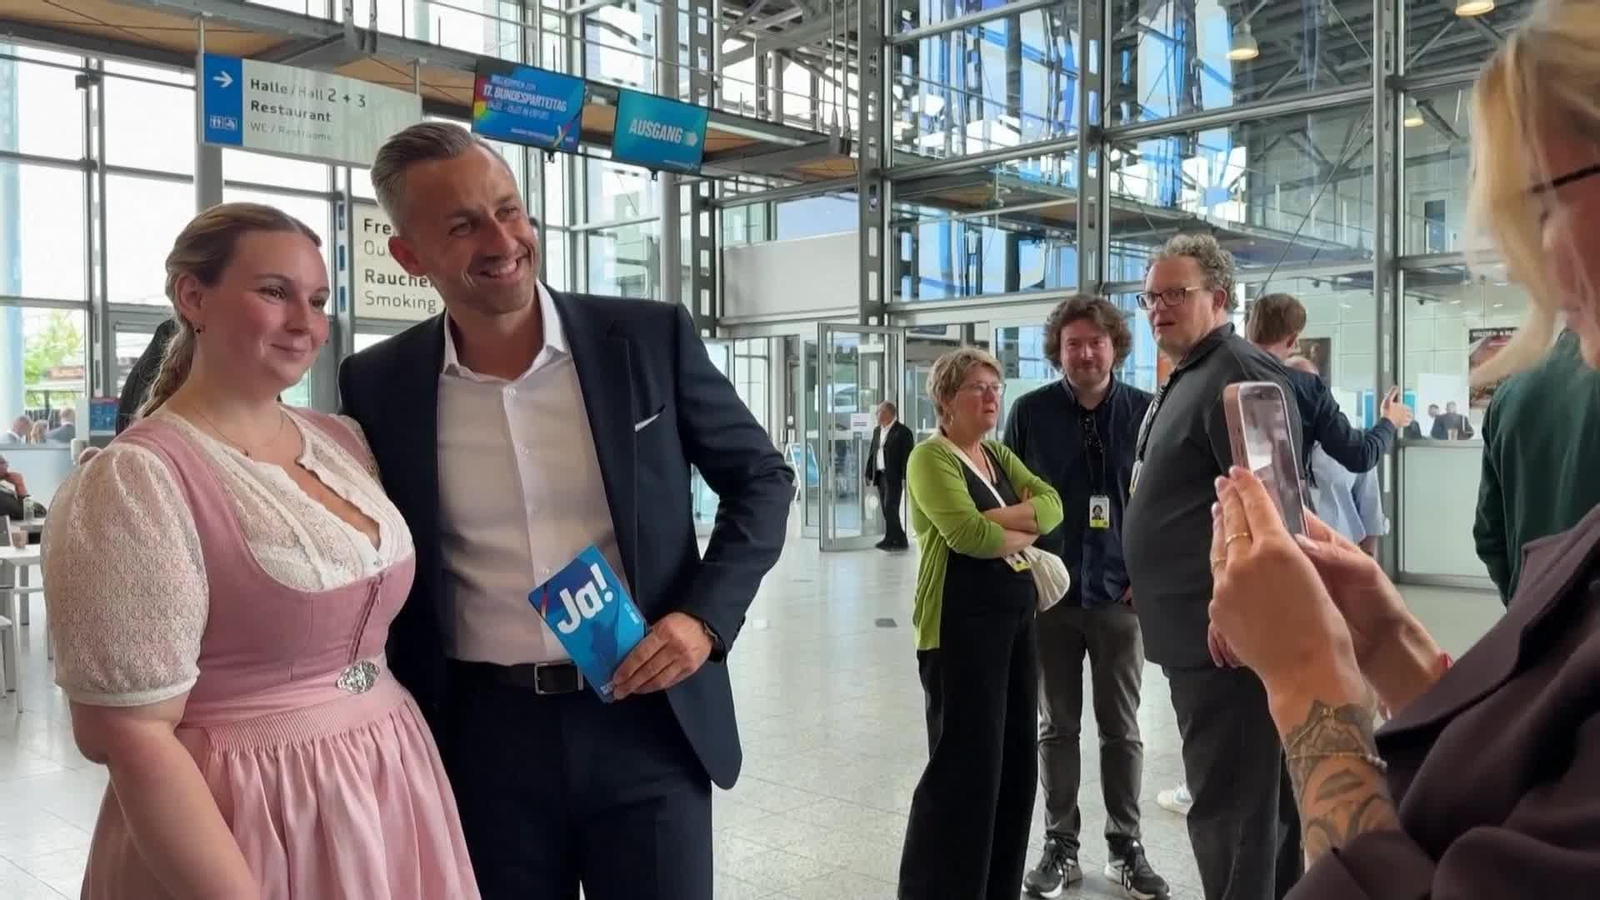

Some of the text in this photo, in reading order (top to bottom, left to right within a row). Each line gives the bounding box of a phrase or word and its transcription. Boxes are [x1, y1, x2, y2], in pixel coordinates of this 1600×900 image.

[250, 78, 288, 95] Halle
[298, 86, 324, 101] Hall
[327, 88, 337, 103] 2
[342, 93, 351, 103] +
[358, 94, 366, 108] 3
[494, 86, 568, 112] BUNDESPARTEITAG
[250, 99, 332, 122] Restaurant
[629, 118, 683, 144] AUSGANG
[364, 218, 392, 235] Fre
[364, 240, 391, 257] Ou
[365, 290, 437, 314] Smoking
[557, 562, 613, 634] Ja!
